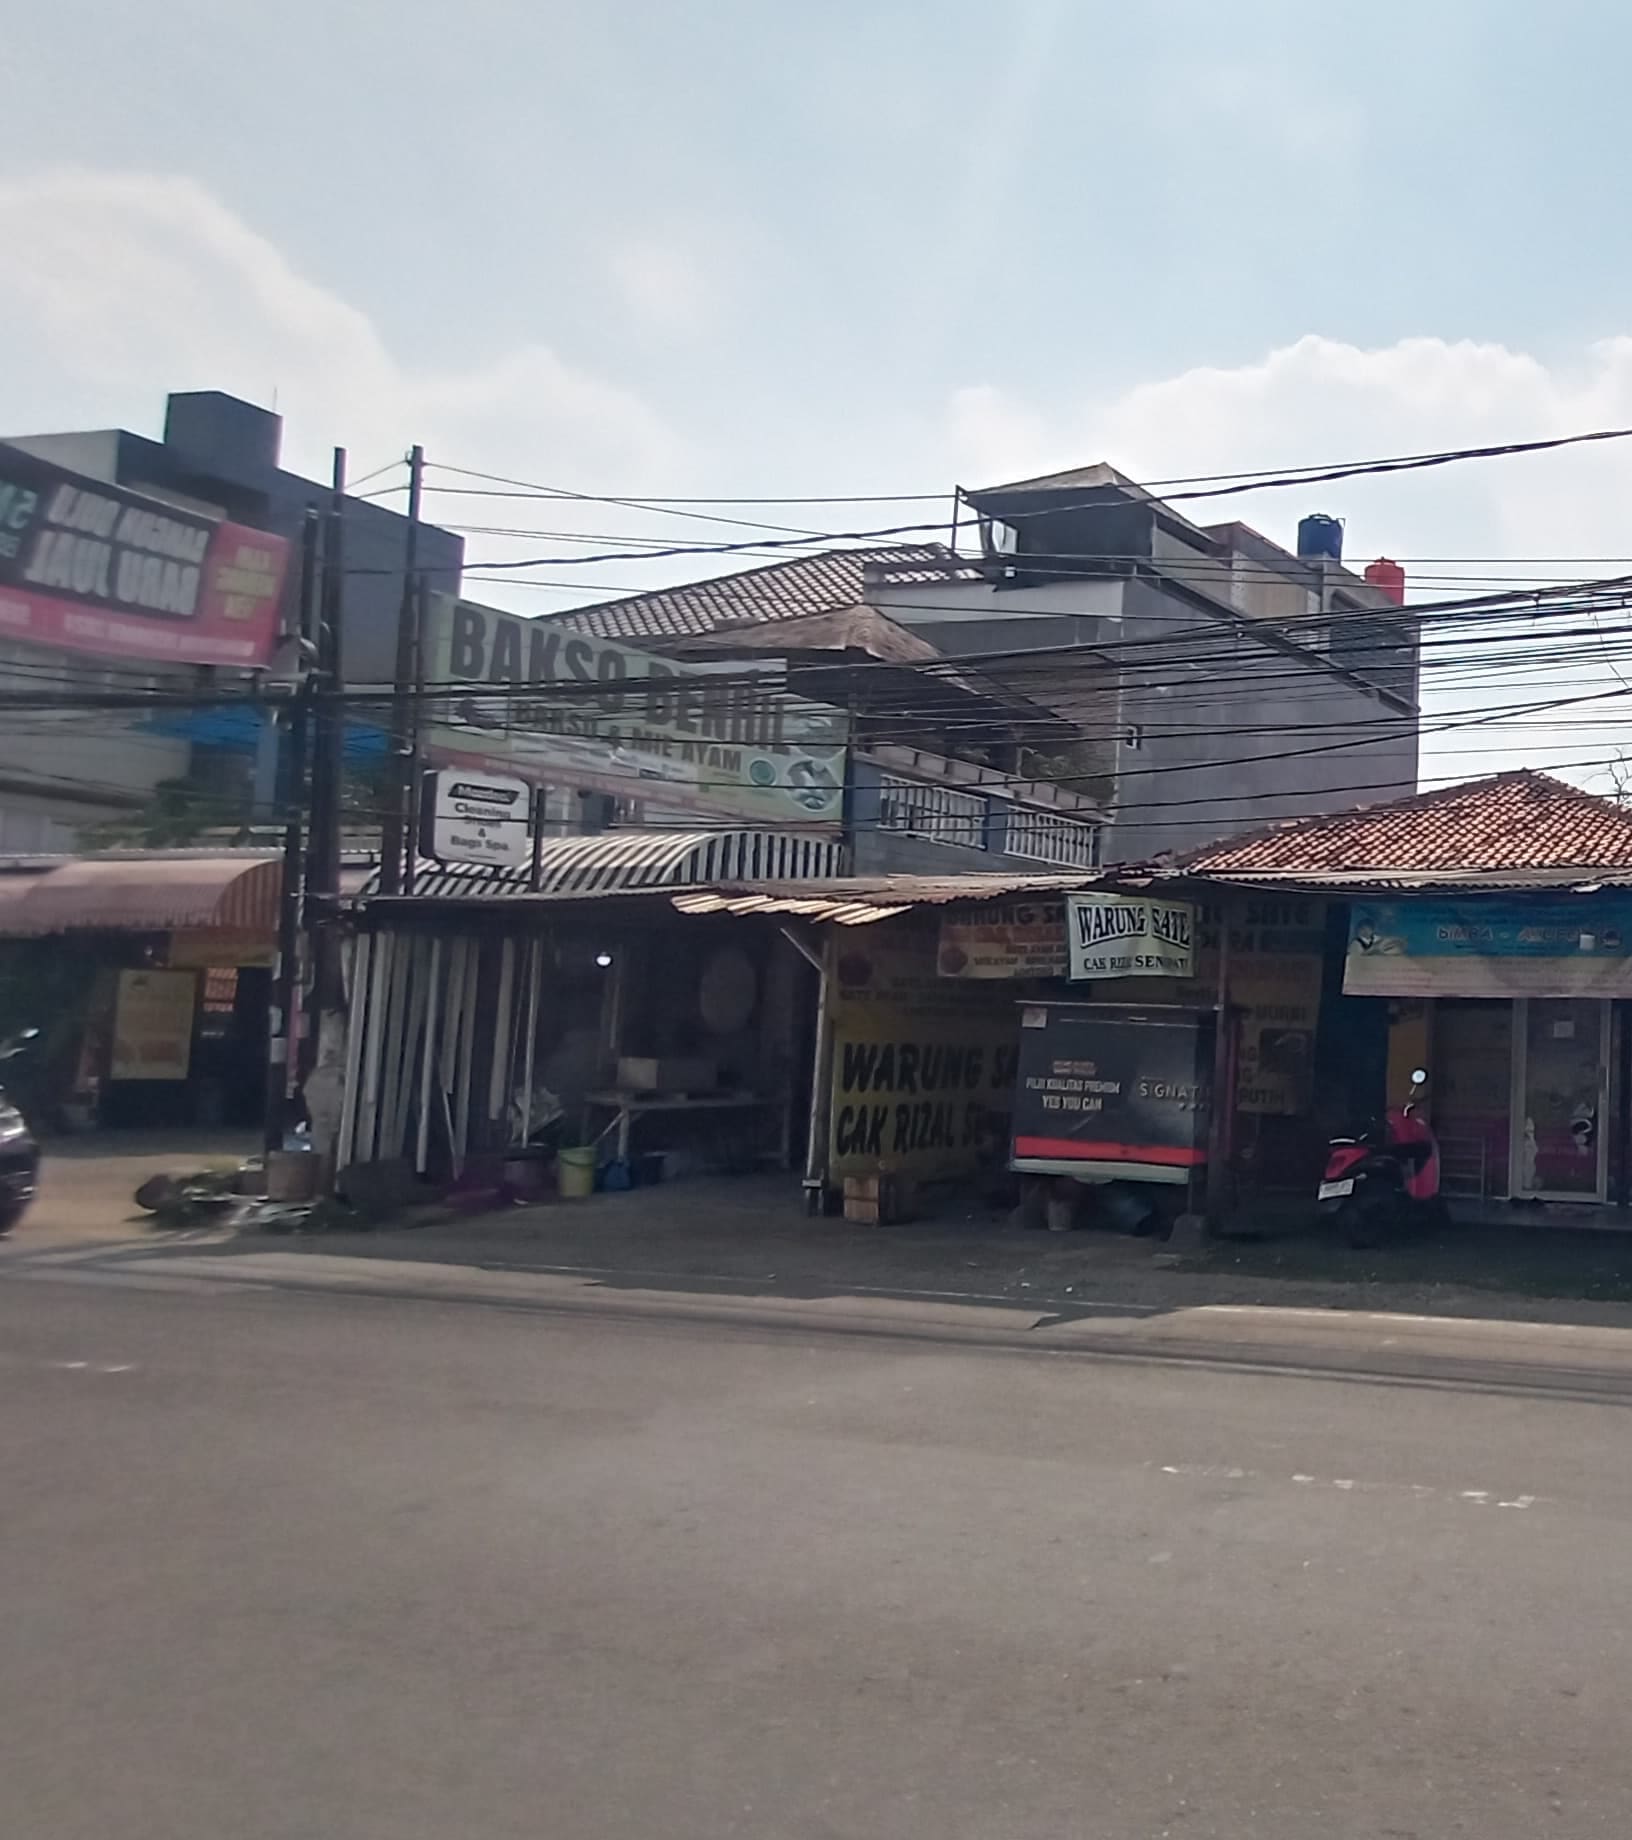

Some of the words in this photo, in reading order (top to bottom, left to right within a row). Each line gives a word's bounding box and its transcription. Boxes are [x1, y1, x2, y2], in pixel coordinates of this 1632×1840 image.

[451, 605, 627, 712] BAKSO
[679, 737, 742, 772] AYAM
[1076, 904, 1147, 946] WARUNG
[1151, 906, 1191, 947] SATE
[1084, 958, 1107, 971] CAK
[842, 1042, 985, 1093] WARUNG
[1062, 1096, 1081, 1110] YOU
[1082, 1097, 1103, 1111] CAN
[836, 1103, 889, 1157] CAK
[892, 1099, 955, 1155] RIZAL
